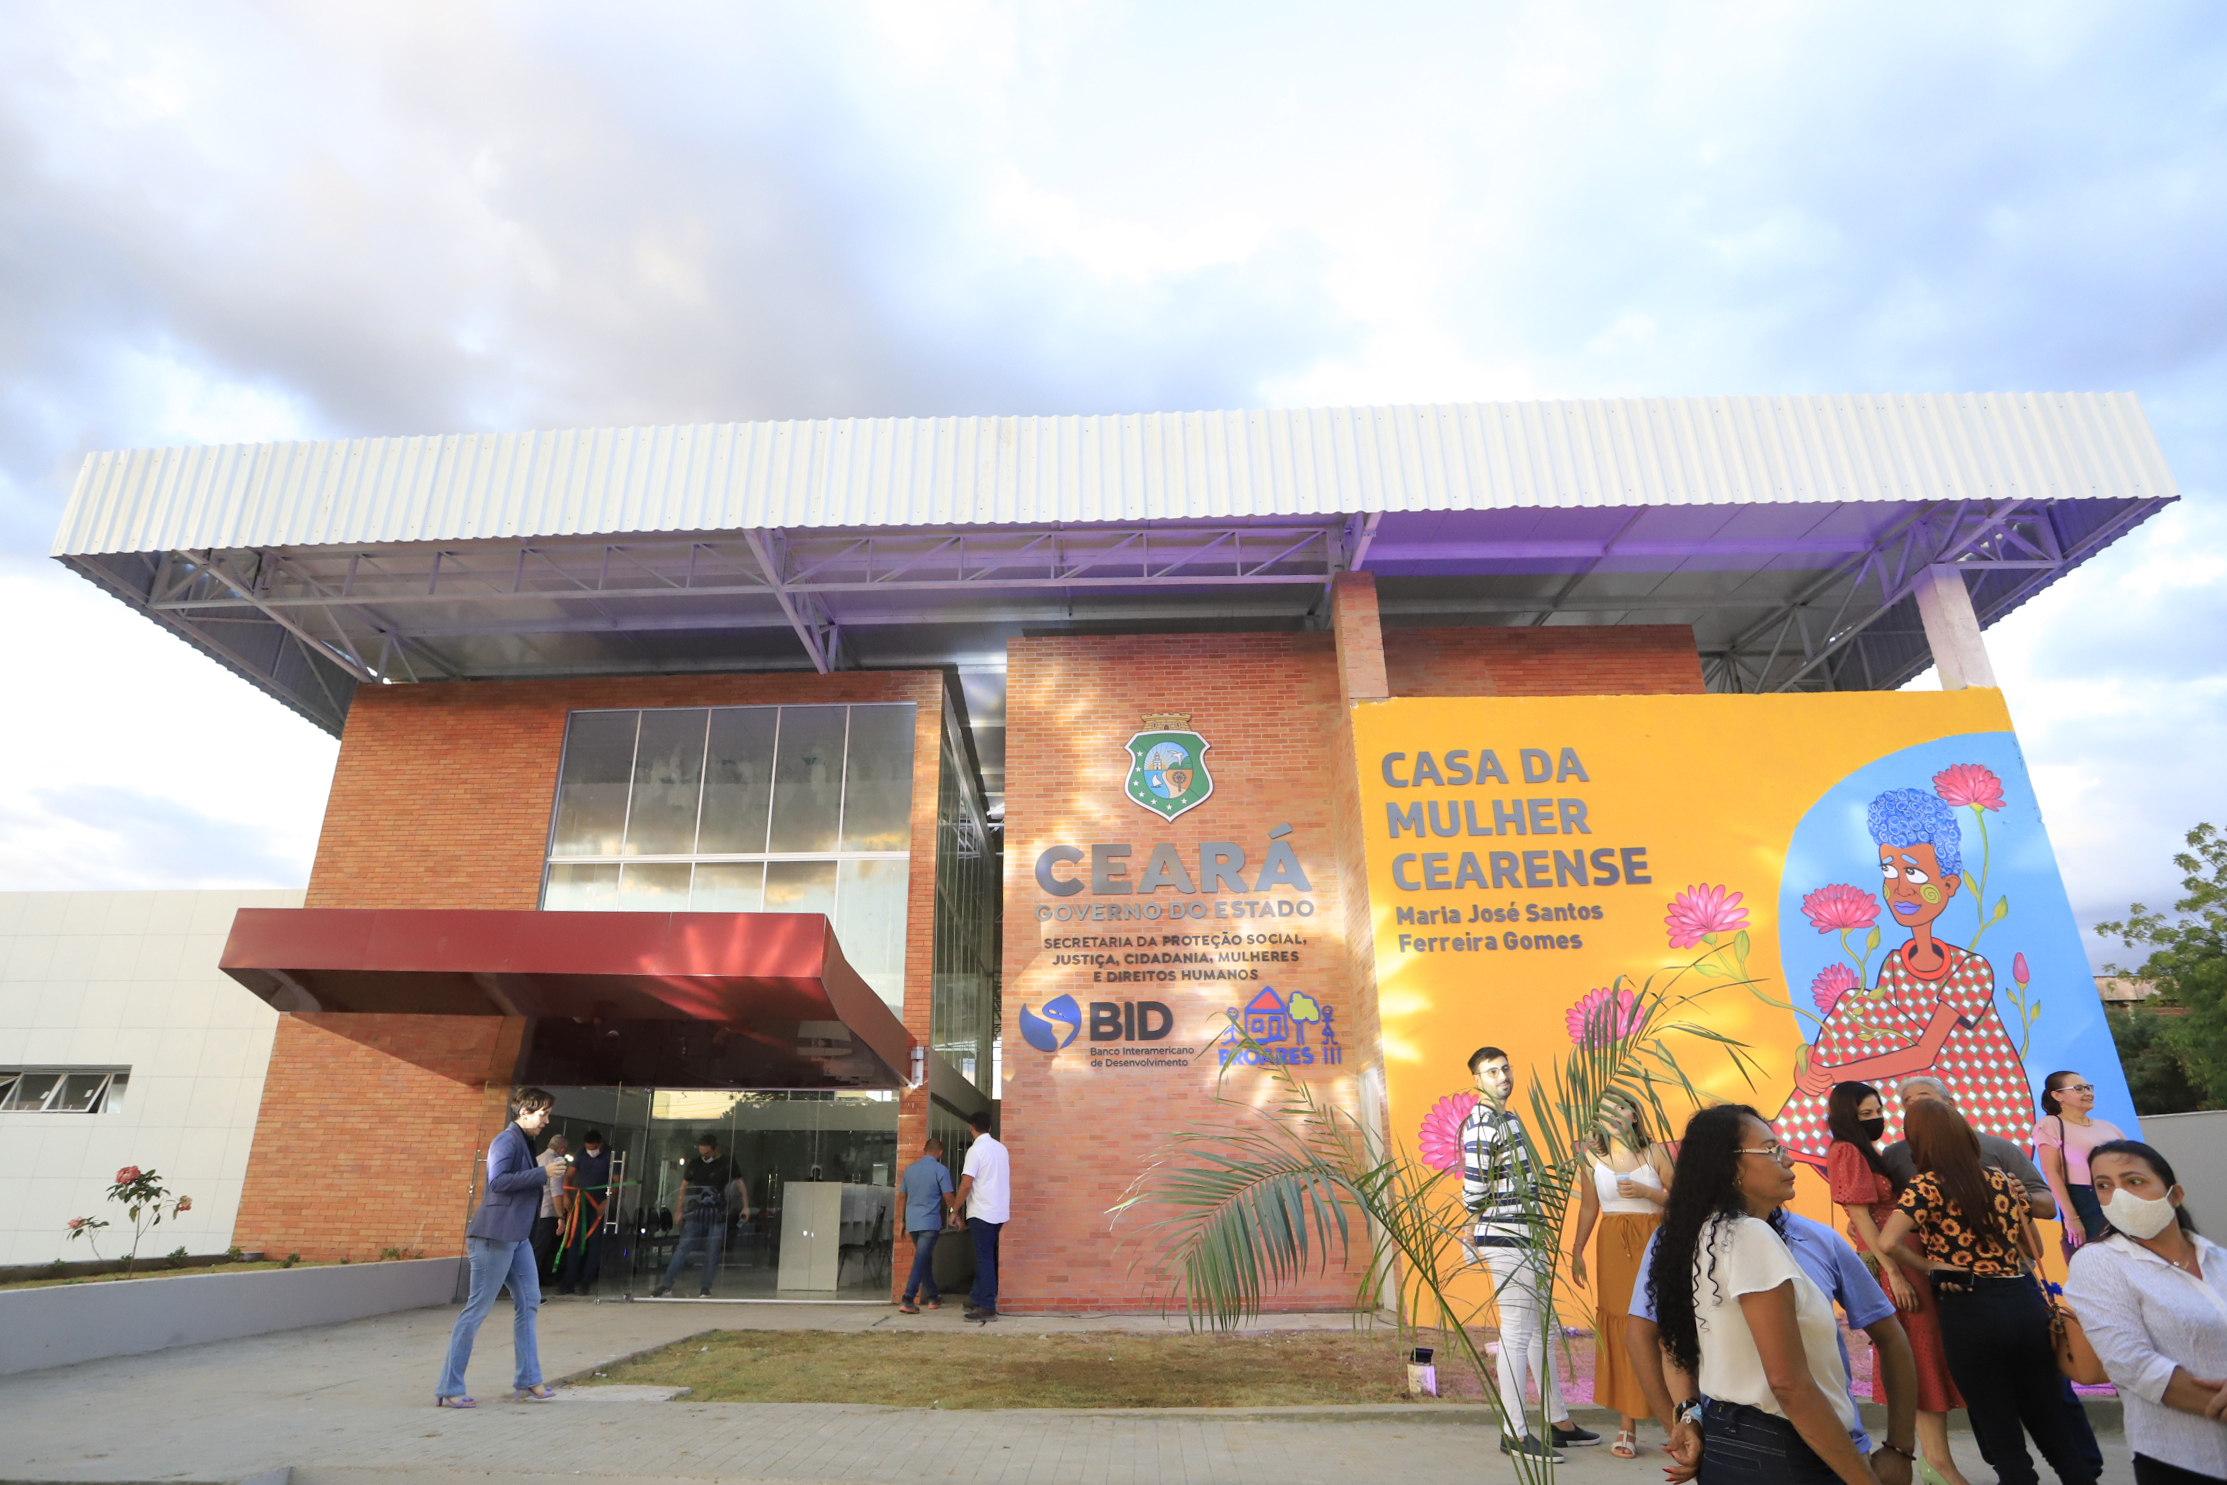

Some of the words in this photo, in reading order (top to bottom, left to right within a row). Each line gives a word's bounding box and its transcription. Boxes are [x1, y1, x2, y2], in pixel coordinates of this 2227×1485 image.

[1381, 749, 1509, 788] CASA
[1519, 747, 1590, 783] DA
[1386, 798, 1592, 838] MULHER
[1035, 822, 1313, 897] CEARÁ
[1392, 847, 1652, 891] CEARENSE
[1035, 902, 1162, 922] GOVERNO
[1170, 901, 1207, 920] DO
[1216, 900, 1314, 918] ESTADO
[1396, 905, 1461, 926] Maria
[1468, 901, 1520, 923] José
[1525, 902, 1604, 923] Santos
[1044, 935, 1134, 949] SECRETARIA
[1137, 935, 1158, 948] DA
[1162, 931, 1243, 948] PROTEÇÃO
[1246, 933, 1307, 946] SOCIAL,
[1398, 932, 1498, 953] Ferreira
[1503, 931, 1583, 951] Gomes
[1052, 953, 1120, 968] JUSTIÇA,
[1124, 951, 1214, 966] CIDADANIA,
[1218, 950, 1300, 963] MULHERES
[1094, 971, 1102, 982] E
[1107, 969, 1177, 983] DIREITOS
[1181, 968, 1259, 981] HUMANOS
[1090, 1001, 1174, 1041] BID
[1090, 1047, 1120, 1057] Banco
[1122, 1045, 1195, 1056] Interamericano
[1090, 1058, 1104, 1067] de
[1105, 1057, 1189, 1068] Desenvolvimento
